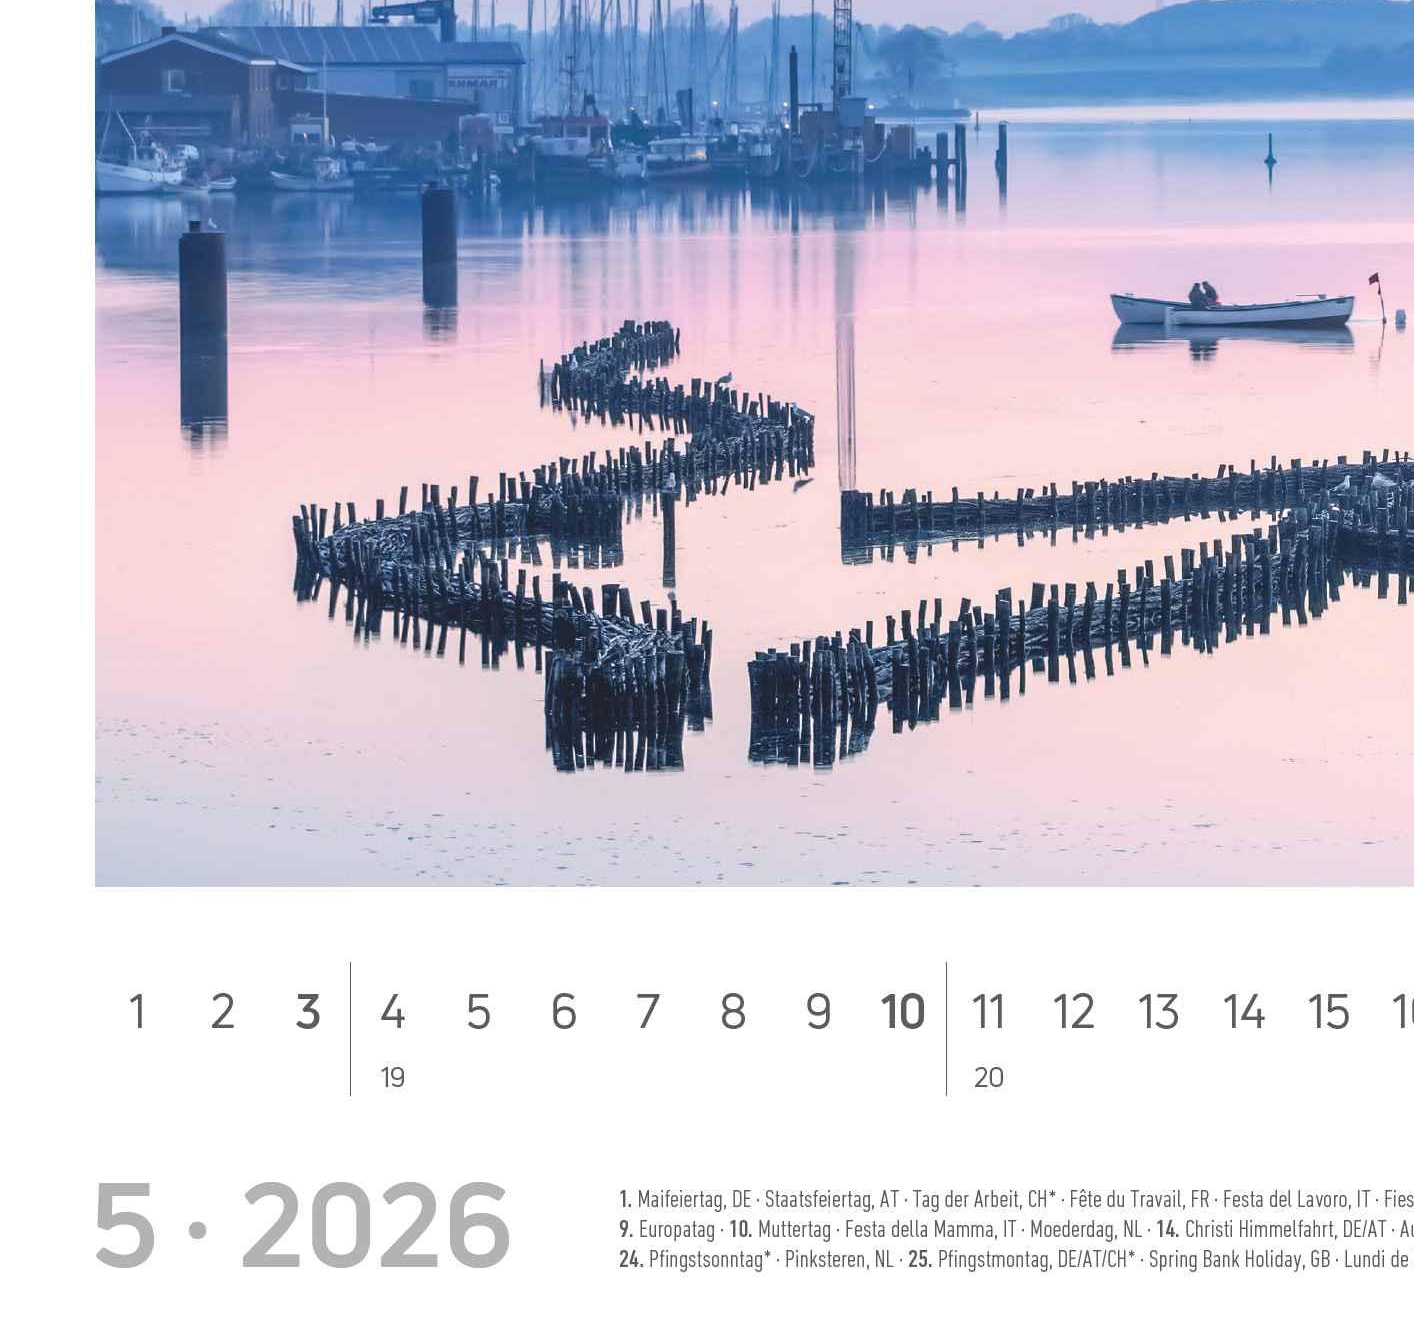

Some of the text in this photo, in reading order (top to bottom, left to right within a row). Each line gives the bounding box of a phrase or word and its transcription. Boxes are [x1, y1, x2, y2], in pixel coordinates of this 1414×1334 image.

[129, 993, 143, 1029] 1
[211, 992, 235, 1029] 2
[295, 993, 321, 1030] 3
[380, 993, 406, 1029] 4
[467, 993, 491, 1030] 5
[552, 992, 577, 1030] 6
[636, 993, 661, 1029] 7
[721, 992, 746, 1030] 8
[806, 992, 831, 1030] 9
[880, 992, 925, 1030] 10
[972, 993, 1003, 1029] 11
[1053, 992, 1095, 1029] 12
[1138, 993, 1179, 1030] 13
[1223, 993, 1266, 1029] 14
[1308, 993, 1350, 1030] 15
[380, 1066, 405, 1088] 19
[974, 1066, 1004, 1088] 20
[619, 1189, 632, 1208] 1.
[638, 1189, 727, 1213] Maifeiertag,
[732, 1189, 752, 1208] DE
[765, 1189, 875, 1213] Staatsfeiertag,
[879, 1189, 900, 1208] AT
[912, 1189, 940, 1213] Tag
[944, 1189, 969, 1208] der
[973, 1189, 1023, 1211] Arbeit,
[1070, 1188, 1102, 1208] Fête
[1106, 1189, 1125, 1208] du
[1130, 1189, 1186, 1211] Travail,
[1191, 1189, 1210, 1208] FR
[1223, 1189, 1264, 1208] Festa
[1269, 1188, 1293, 1208] del
[1297, 1188, 1352, 1211] Lavoro,
[1357, 1188, 1372, 1208] IT
[95, 1181, 510, 1269] 5 2026
[619, 1219, 634, 1238] 9.
[639, 1219, 715, 1243] Europatag
[729, 1219, 753, 1238] 10.
[758, 1219, 831, 1243] Muttertag
[845, 1219, 886, 1238] Festa
[891, 1219, 928, 1238] della
[934, 1219, 998, 1241] Mamma,
[1003, 1219, 1017, 1238] IT
[1030, 1219, 1118, 1243] Moederdag,
[1123, 1219, 1143, 1238] NL
[1156, 1219, 1180, 1238] 14.
[1185, 1219, 1233, 1238] Christi
[1239, 1219, 1338, 1241] Himmelfahrt,
[1343, 1219, 1388, 1238] DE/AT
[619, 1249, 644, 1268] 24.
[785, 1248, 870, 1270] Pinksteren,
[875, 1249, 895, 1268] NL
[908, 1249, 933, 1268] 25.
[938, 1249, 1053, 1273] Pfingstmontag,
[1149, 1249, 1198, 1273] Spring
[1203, 1249, 1240, 1268] Bank
[1245, 1248, 1306, 1273] Holiday,
[1310, 1249, 1331, 1268] GB
[1344, 1249, 1385, 1268] Lundi
[1390, 1249, 1409, 1268] de
